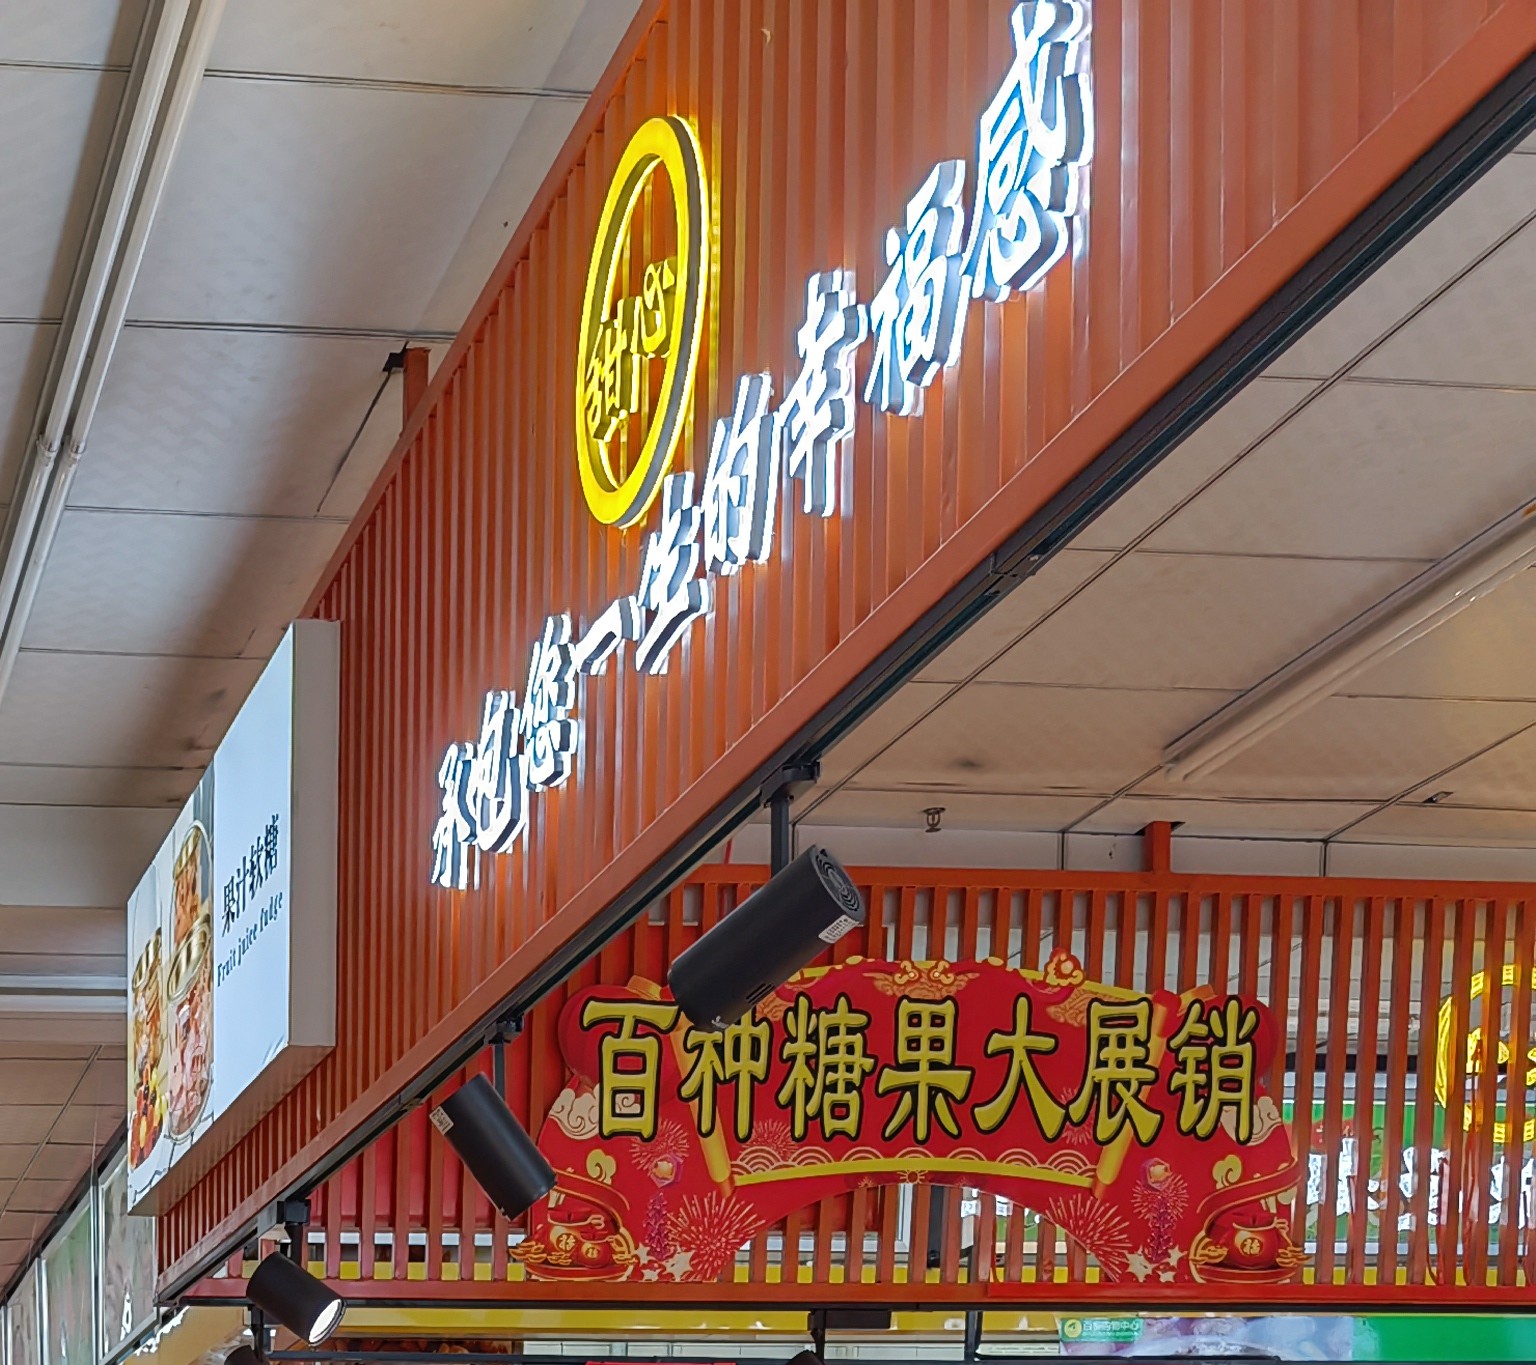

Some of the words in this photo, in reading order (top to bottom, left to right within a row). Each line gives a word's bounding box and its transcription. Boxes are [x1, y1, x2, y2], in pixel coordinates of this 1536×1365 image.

[222, 814, 279, 938] 果汁软糖
[217, 948, 237, 987] Fruit
[237, 923, 258, 966] juice
[579, 994, 1261, 1146] 百种糖果大展销
